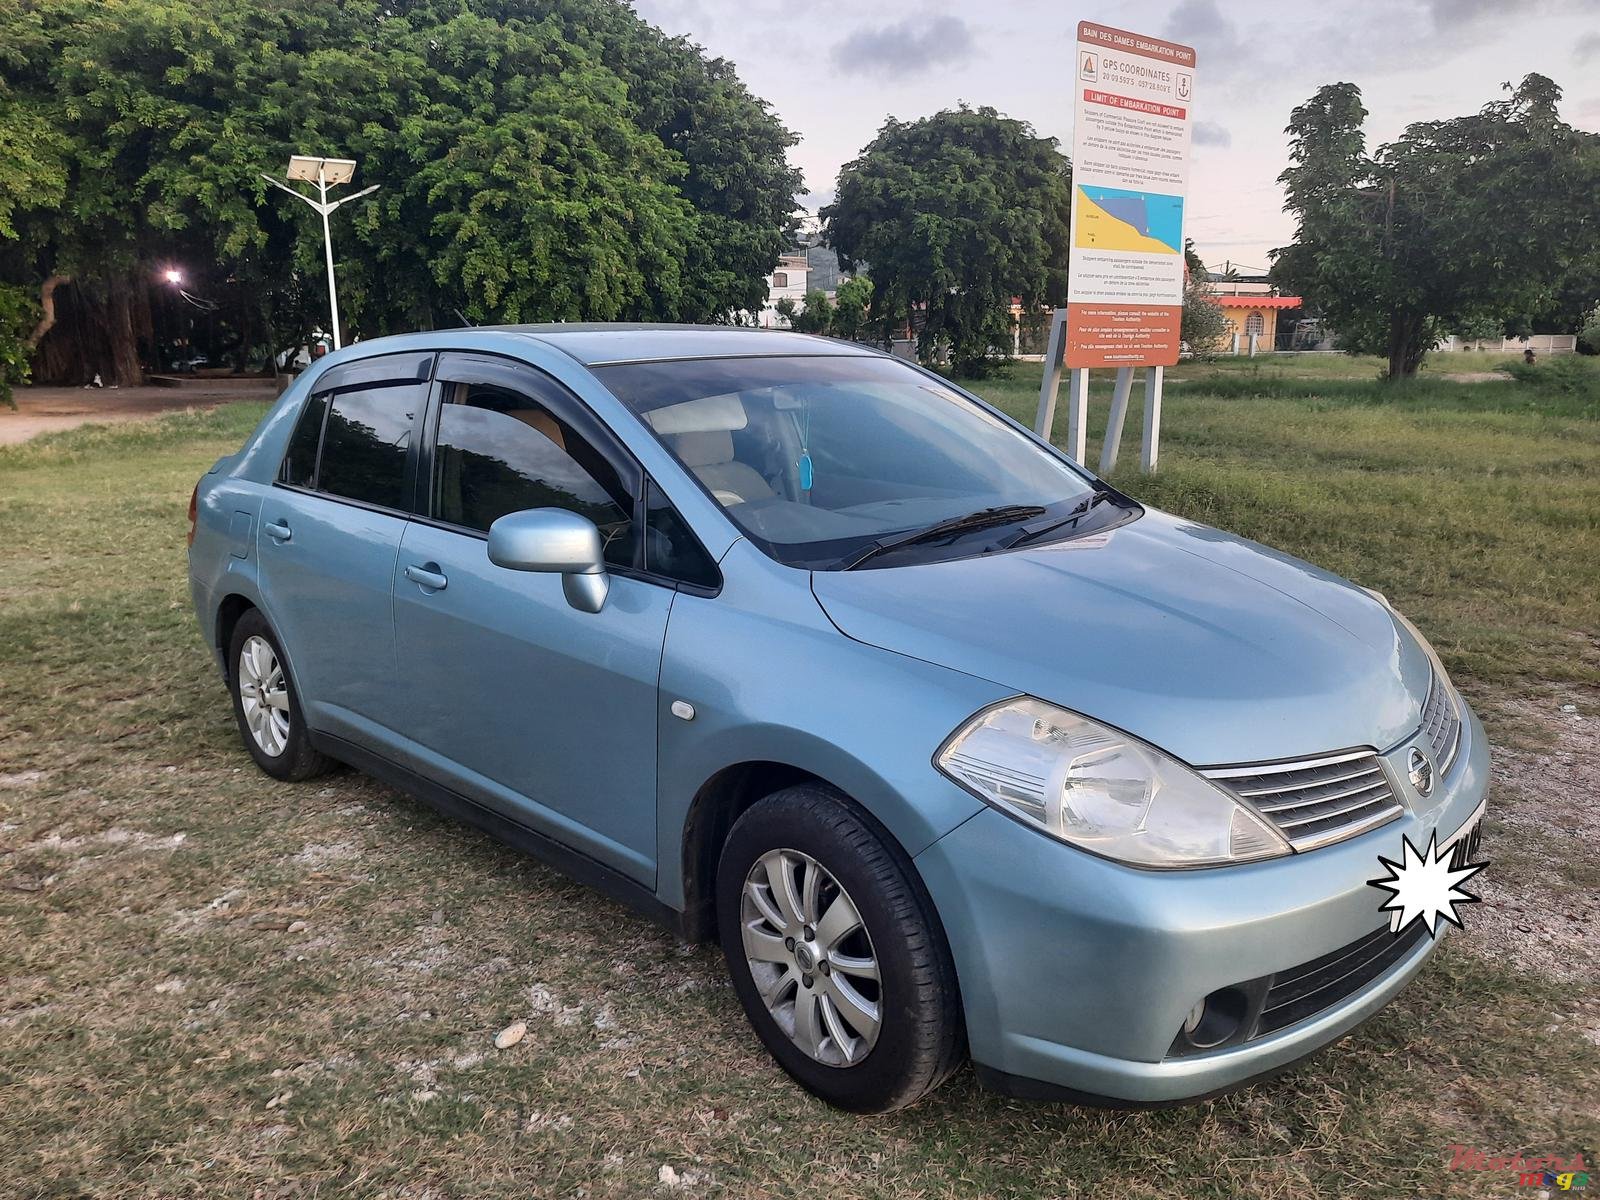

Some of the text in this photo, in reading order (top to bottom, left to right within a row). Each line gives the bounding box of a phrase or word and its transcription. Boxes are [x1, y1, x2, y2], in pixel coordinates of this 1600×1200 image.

[1084, 28, 1191, 60] BAIN DES DAMES EMBARKATION POINT
[1103, 59, 1170, 81] GPS COORDINATES
[1091, 93, 1179, 116] LIMIT OF EMBARKATION POINT
